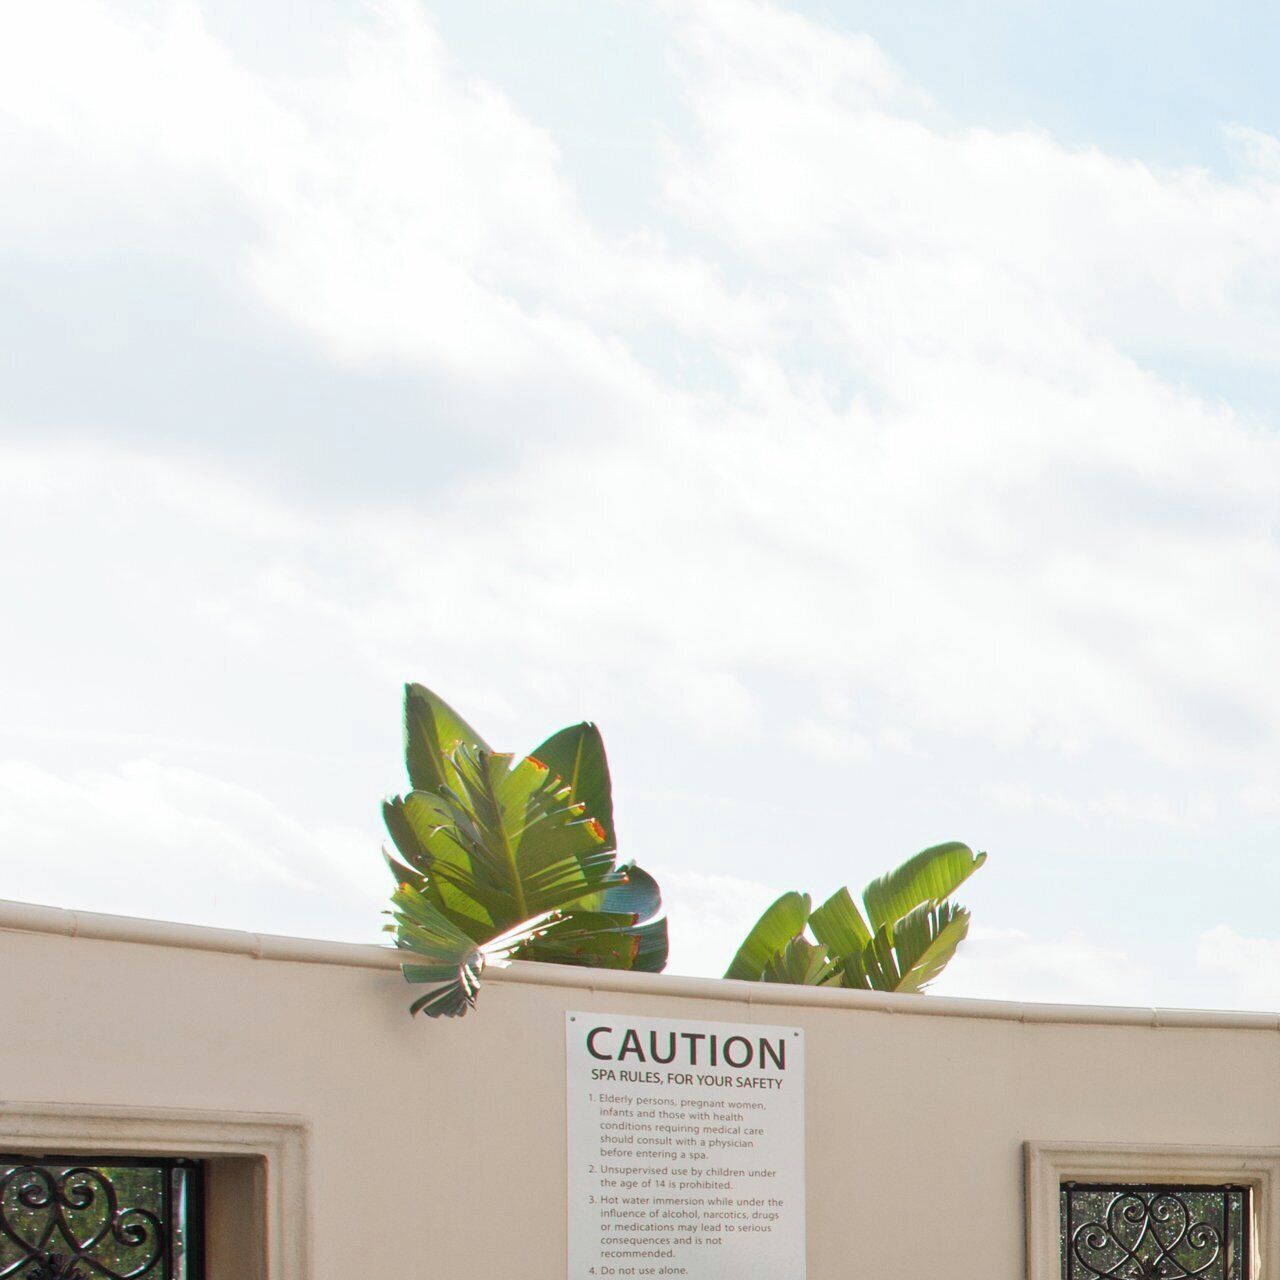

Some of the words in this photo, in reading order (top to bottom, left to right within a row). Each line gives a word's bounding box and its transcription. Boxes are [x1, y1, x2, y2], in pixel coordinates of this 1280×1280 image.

[586, 1026, 786, 1070] CAUTION
[592, 1069, 616, 1081] SPA
[620, 1072, 664, 1085] RULES,
[668, 1074, 693, 1085] FOR
[696, 1075, 732, 1087] YOUR
[736, 1078, 783, 1089] SAFETY
[589, 1094, 596, 1102] 1.
[600, 1094, 633, 1106] Elderly
[637, 1097, 677, 1107] persons,
[681, 1099, 724, 1109] pregnant
[728, 1101, 766, 1110] women,
[600, 1107, 633, 1118] infants
[637, 1109, 655, 1118] and
[659, 1110, 685, 1119] those
[689, 1112, 710, 1120] with
[714, 1112, 743, 1121] health
[600, 1121, 652, 1131] conditions
[655, 1125, 699, 1135] requiring
[703, 1126, 740, 1135] medical
[600, 1135, 633, 1144] should
[637, 1137, 672, 1145] consult
[676, 1137, 697, 1146] with
[709, 1139, 753, 1149] physician
[600, 1148, 632, 1158] before
[636, 1151, 677, 1160] entering
[689, 1152, 708, 1161] spa.
[589, 1165, 597, 1174] 2.
[601, 1165, 668, 1177] Unsupervised
[691, 1167, 702, 1177] by
[706, 1168, 745, 1177] children
[749, 1168, 776, 1177] under
[601, 1179, 616, 1188] the
[620, 1181, 638, 1189] age
[642, 1180, 652, 1188] of
[656, 1180, 665, 1188] 14
[680, 1180, 733, 1190] prohibited.
[589, 1196, 597, 1204] 3.
[601, 1196, 618, 1205] Hot
[622, 1197, 649, 1205] water
[653, 1197, 704, 1205] immersion
[708, 1197, 733, 1206] while
[737, 1198, 764, 1207] under
[768, 1198, 784, 1207] the
[601, 1209, 646, 1218] influence
[650, 1209, 659, 1218] of
[662, 1210, 700, 1220] alcohol,
[704, 1210, 749, 1220] narcotics,
[752, 1211, 779, 1220] drugs
[615, 1223, 674, 1232] medications
[678, 1224, 697, 1233] may
[701, 1223, 721, 1232] lead
[725, 1224, 734, 1232] to
[738, 1224, 771, 1232] serious
[601, 1237, 670, 1247] consequences
[674, 1236, 692, 1245] and
[696, 1237, 702, 1245] is
[706, 1237, 722, 1245] not
[601, 1249, 675, 1258] recommended.
[589, 1267, 597, 1275] 4.
[601, 1267, 615, 1275] Do
[659, 1266, 688, 1275] alone.
